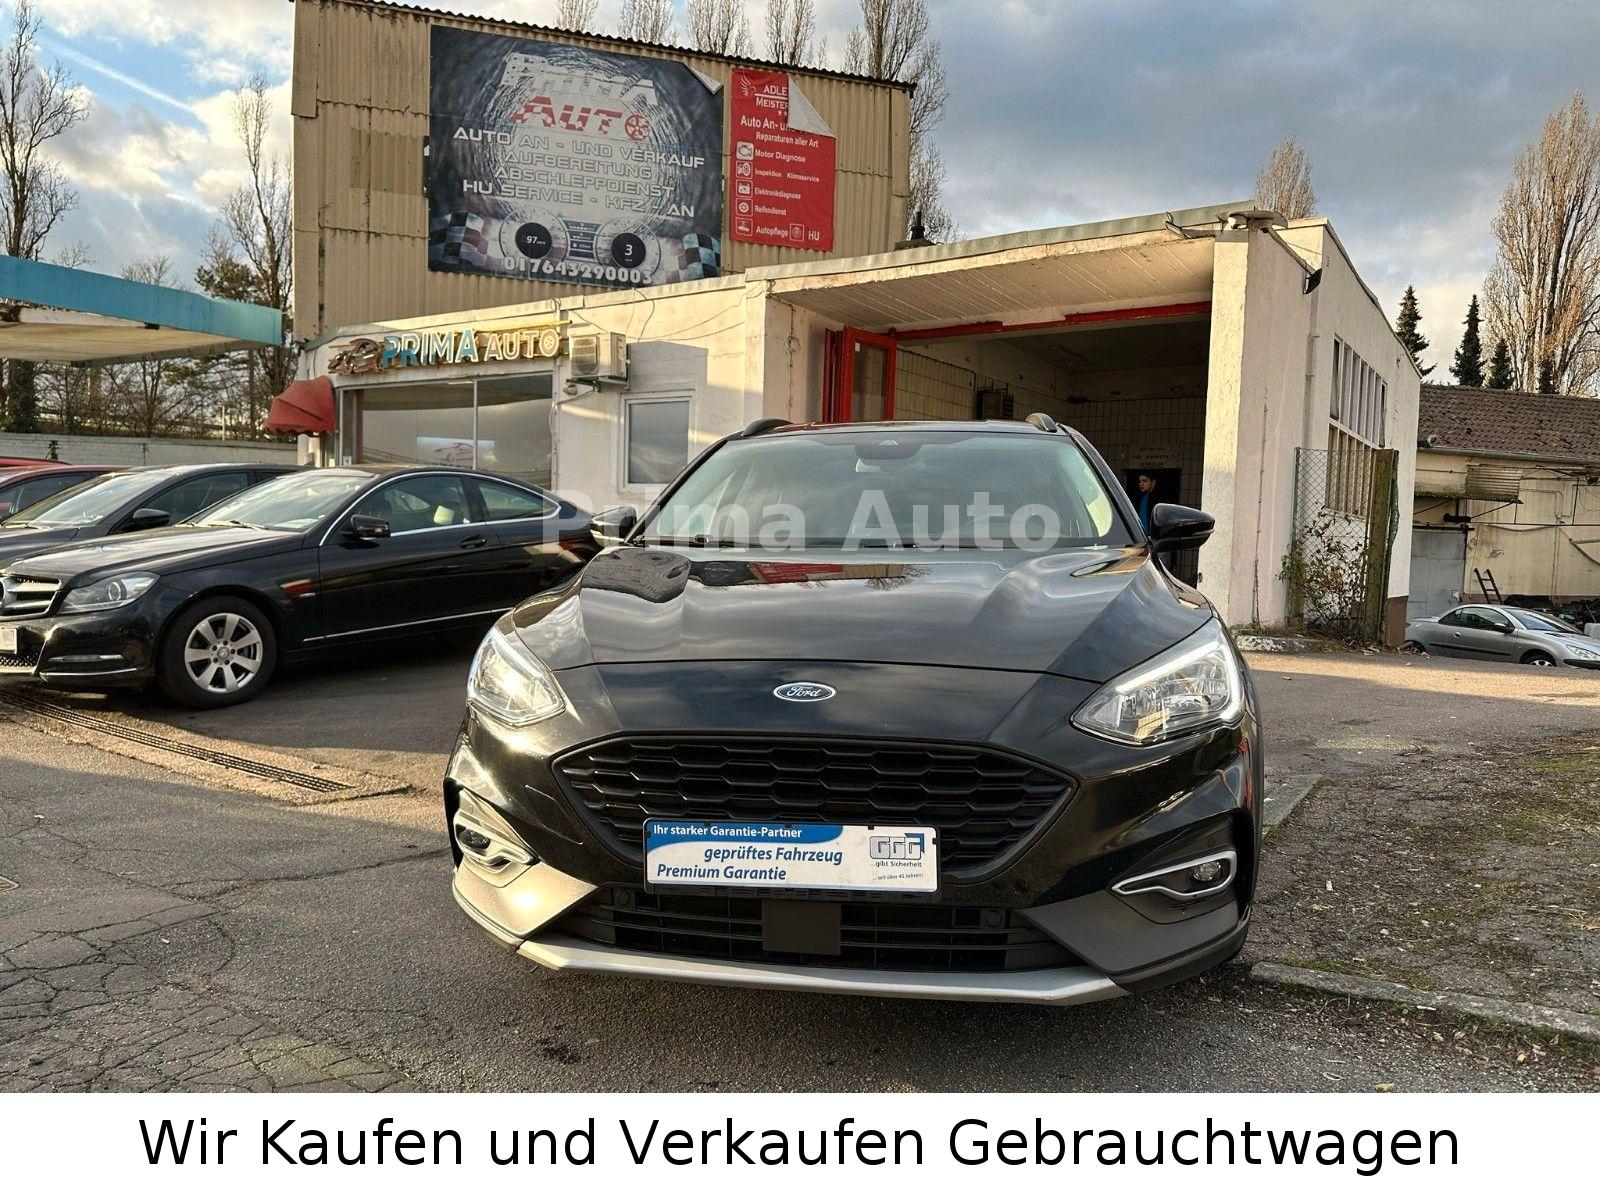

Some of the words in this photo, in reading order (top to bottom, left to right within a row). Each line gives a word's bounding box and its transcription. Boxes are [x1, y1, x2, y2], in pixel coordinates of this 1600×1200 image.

[763, 84, 789, 97] ADLE
[740, 115, 762, 128] Auto
[763, 118, 779, 130] An-
[453, 127, 512, 145] AUTO
[519, 134, 549, 150] AN
[572, 141, 613, 158] UND
[620, 147, 705, 169] VERKAUF
[755, 131, 794, 145] Reparaturen
[795, 137, 808, 147] aller
[809, 139, 819, 149] Art
[755, 149, 774, 159] Motor
[775, 151, 806, 163] Diagnose
[504, 149, 653, 180] AUFBEREITUNG
[494, 166, 675, 198] ABSCHLEPPDIENST
[754, 168, 782, 179] Inspektion
[786, 172, 820, 183] Klimaservice
[463, 179, 493, 195] HU
[501, 183, 583, 206] SERVICE
[605, 195, 647, 214] KFZ
[667, 203, 695, 218] AN
[808, 230, 820, 241] HU
[624, 244, 634, 256] 3
[380, 328, 479, 369] PRIMA
[484, 329, 560, 362] AUTO
[653, 824, 668, 835] Ihr
[670, 825, 709, 836] starker
[711, 825, 803, 838] Garantie-Partner
[704, 846, 772, 863] geprüftes
[775, 847, 843, 866] Fahrzeug
[890, 860, 922, 868] Sicherheit
[657, 863, 720, 879] Premium
[723, 866, 787, 881] Garantie
